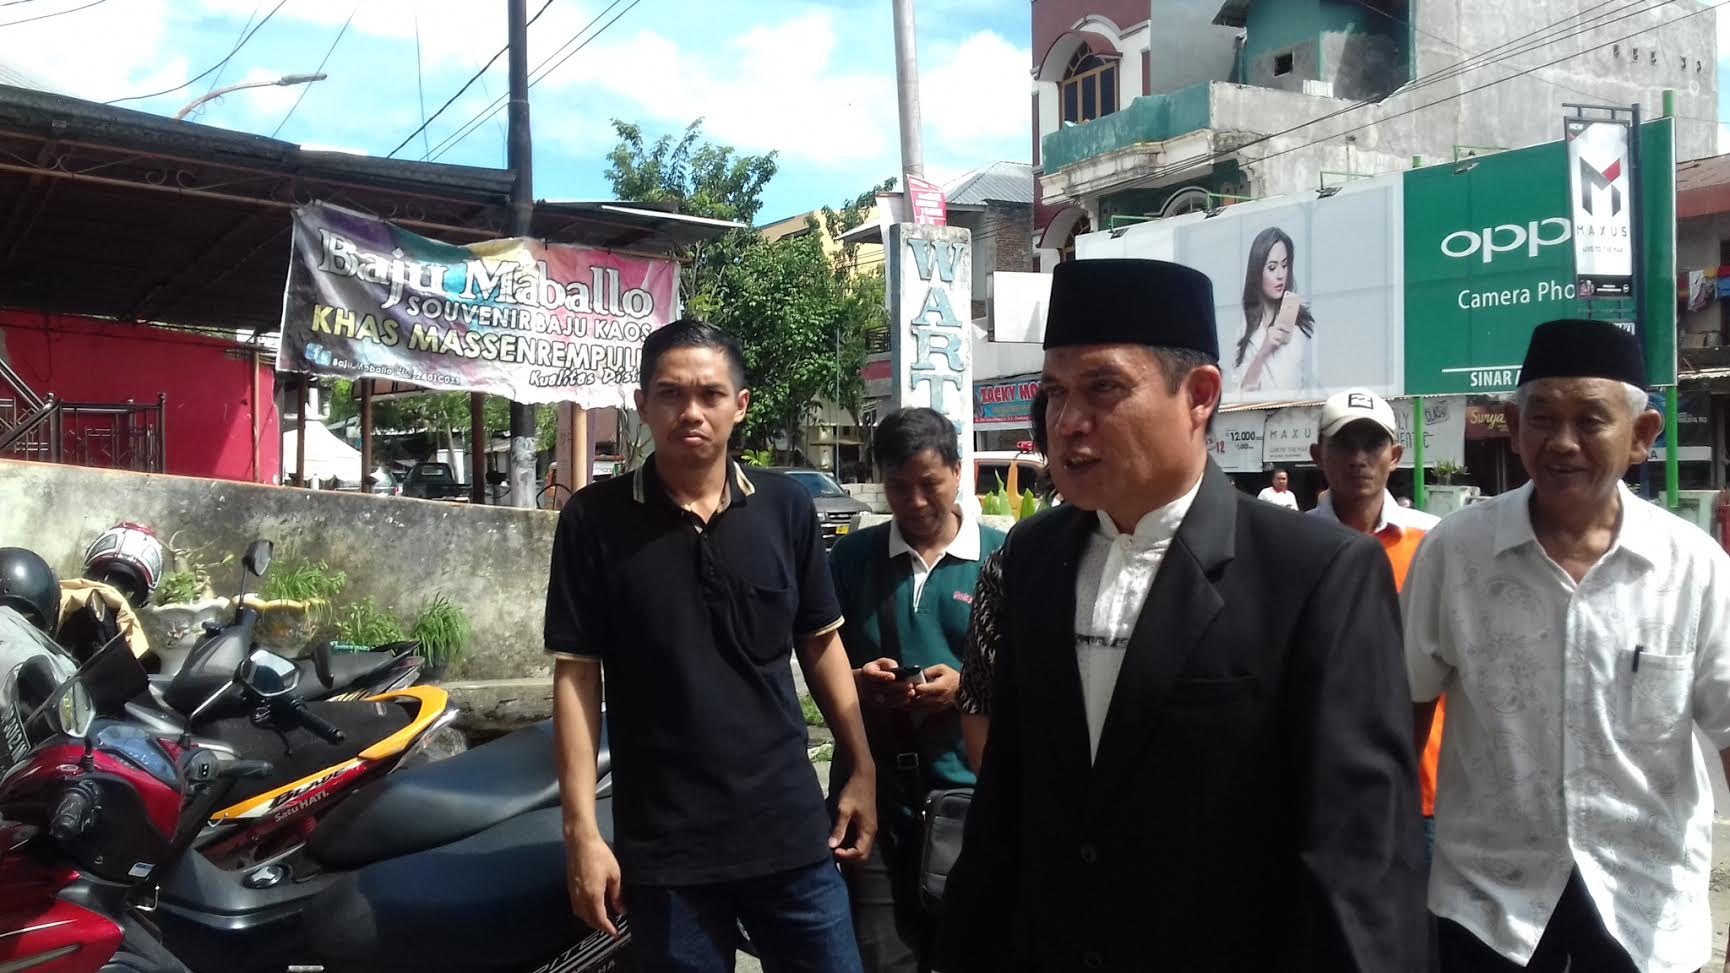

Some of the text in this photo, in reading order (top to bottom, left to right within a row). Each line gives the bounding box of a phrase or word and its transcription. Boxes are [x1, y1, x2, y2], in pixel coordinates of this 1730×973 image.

[1440, 217, 1571, 263] opp
[1576, 225, 1628, 237] MAXUS
[318, 228, 654, 319] Baju Maballo
[1458, 280, 1575, 309] Camera Pho
[311, 303, 400, 347] KHAS
[406, 296, 652, 343] SOUVENIR BAJU KAOS
[529, 367, 641, 387] Kualitas Dist
[1470, 370, 1512, 387] SINAR
[979, 381, 1041, 404] ZACKY MO
[1472, 409, 1508, 430] Surya
[1270, 428, 1311, 440] MAXU
[274, 805, 299, 822] Satu
